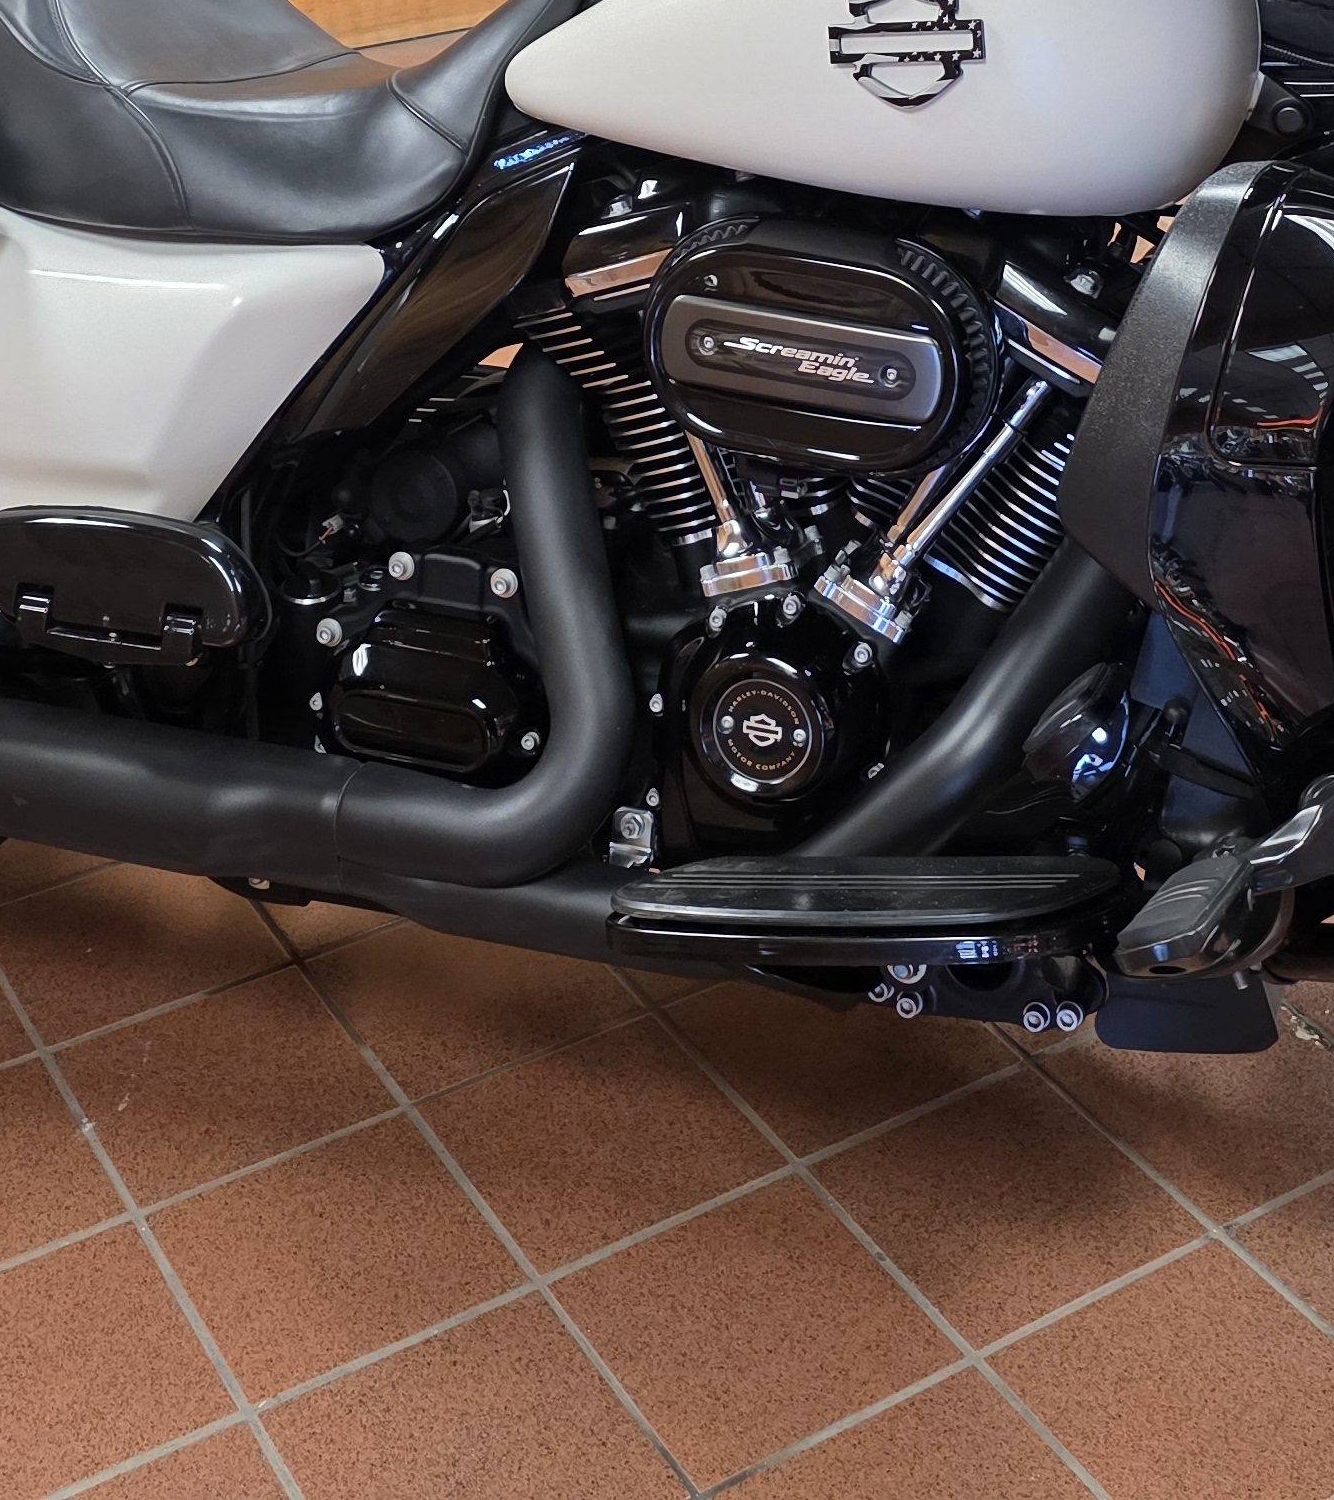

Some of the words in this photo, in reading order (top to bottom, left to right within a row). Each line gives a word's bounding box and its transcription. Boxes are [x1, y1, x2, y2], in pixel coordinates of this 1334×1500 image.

[797, 361, 875, 383] Eagle
[727, 739, 753, 767] MOTOR
[755, 751, 796, 771] COMPANY
